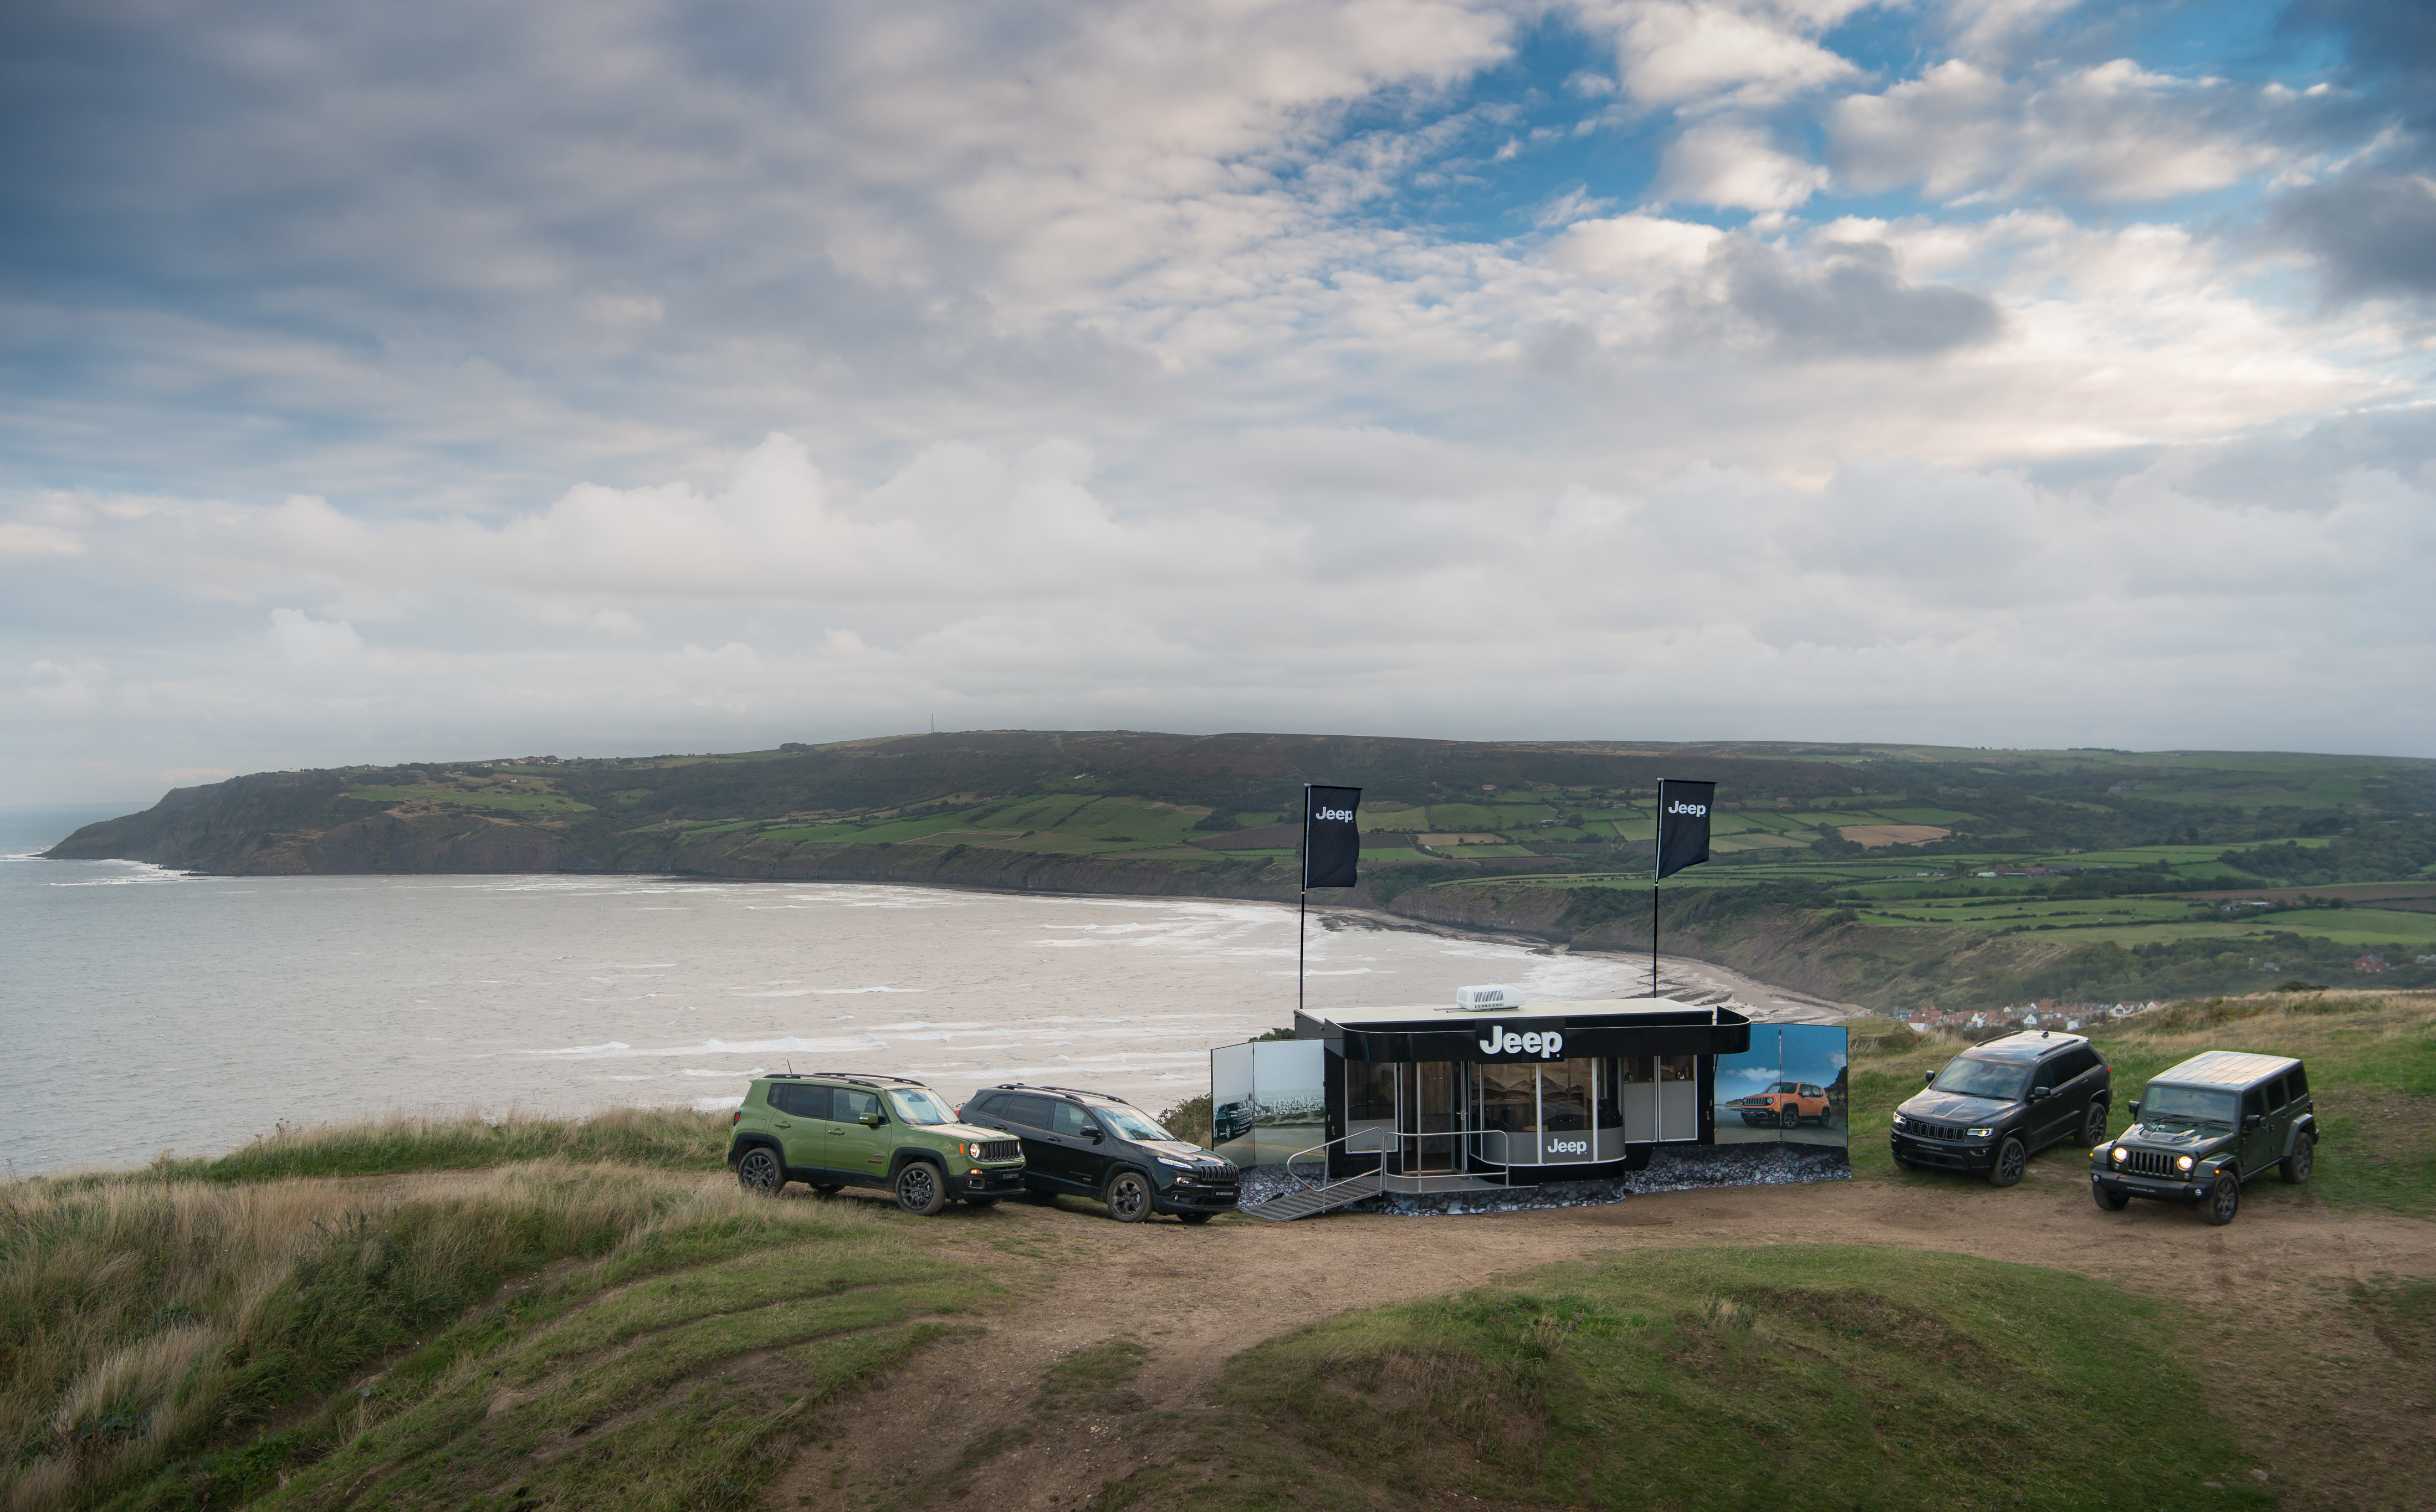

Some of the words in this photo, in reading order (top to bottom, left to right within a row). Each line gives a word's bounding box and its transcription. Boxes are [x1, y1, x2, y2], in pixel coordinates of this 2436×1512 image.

[1316, 806, 1353, 823] Jeep
[1668, 800, 1706, 817] Jeep
[1480, 1025, 1563, 1058] Jeep
[1547, 1138, 1587, 1155] Jeep
